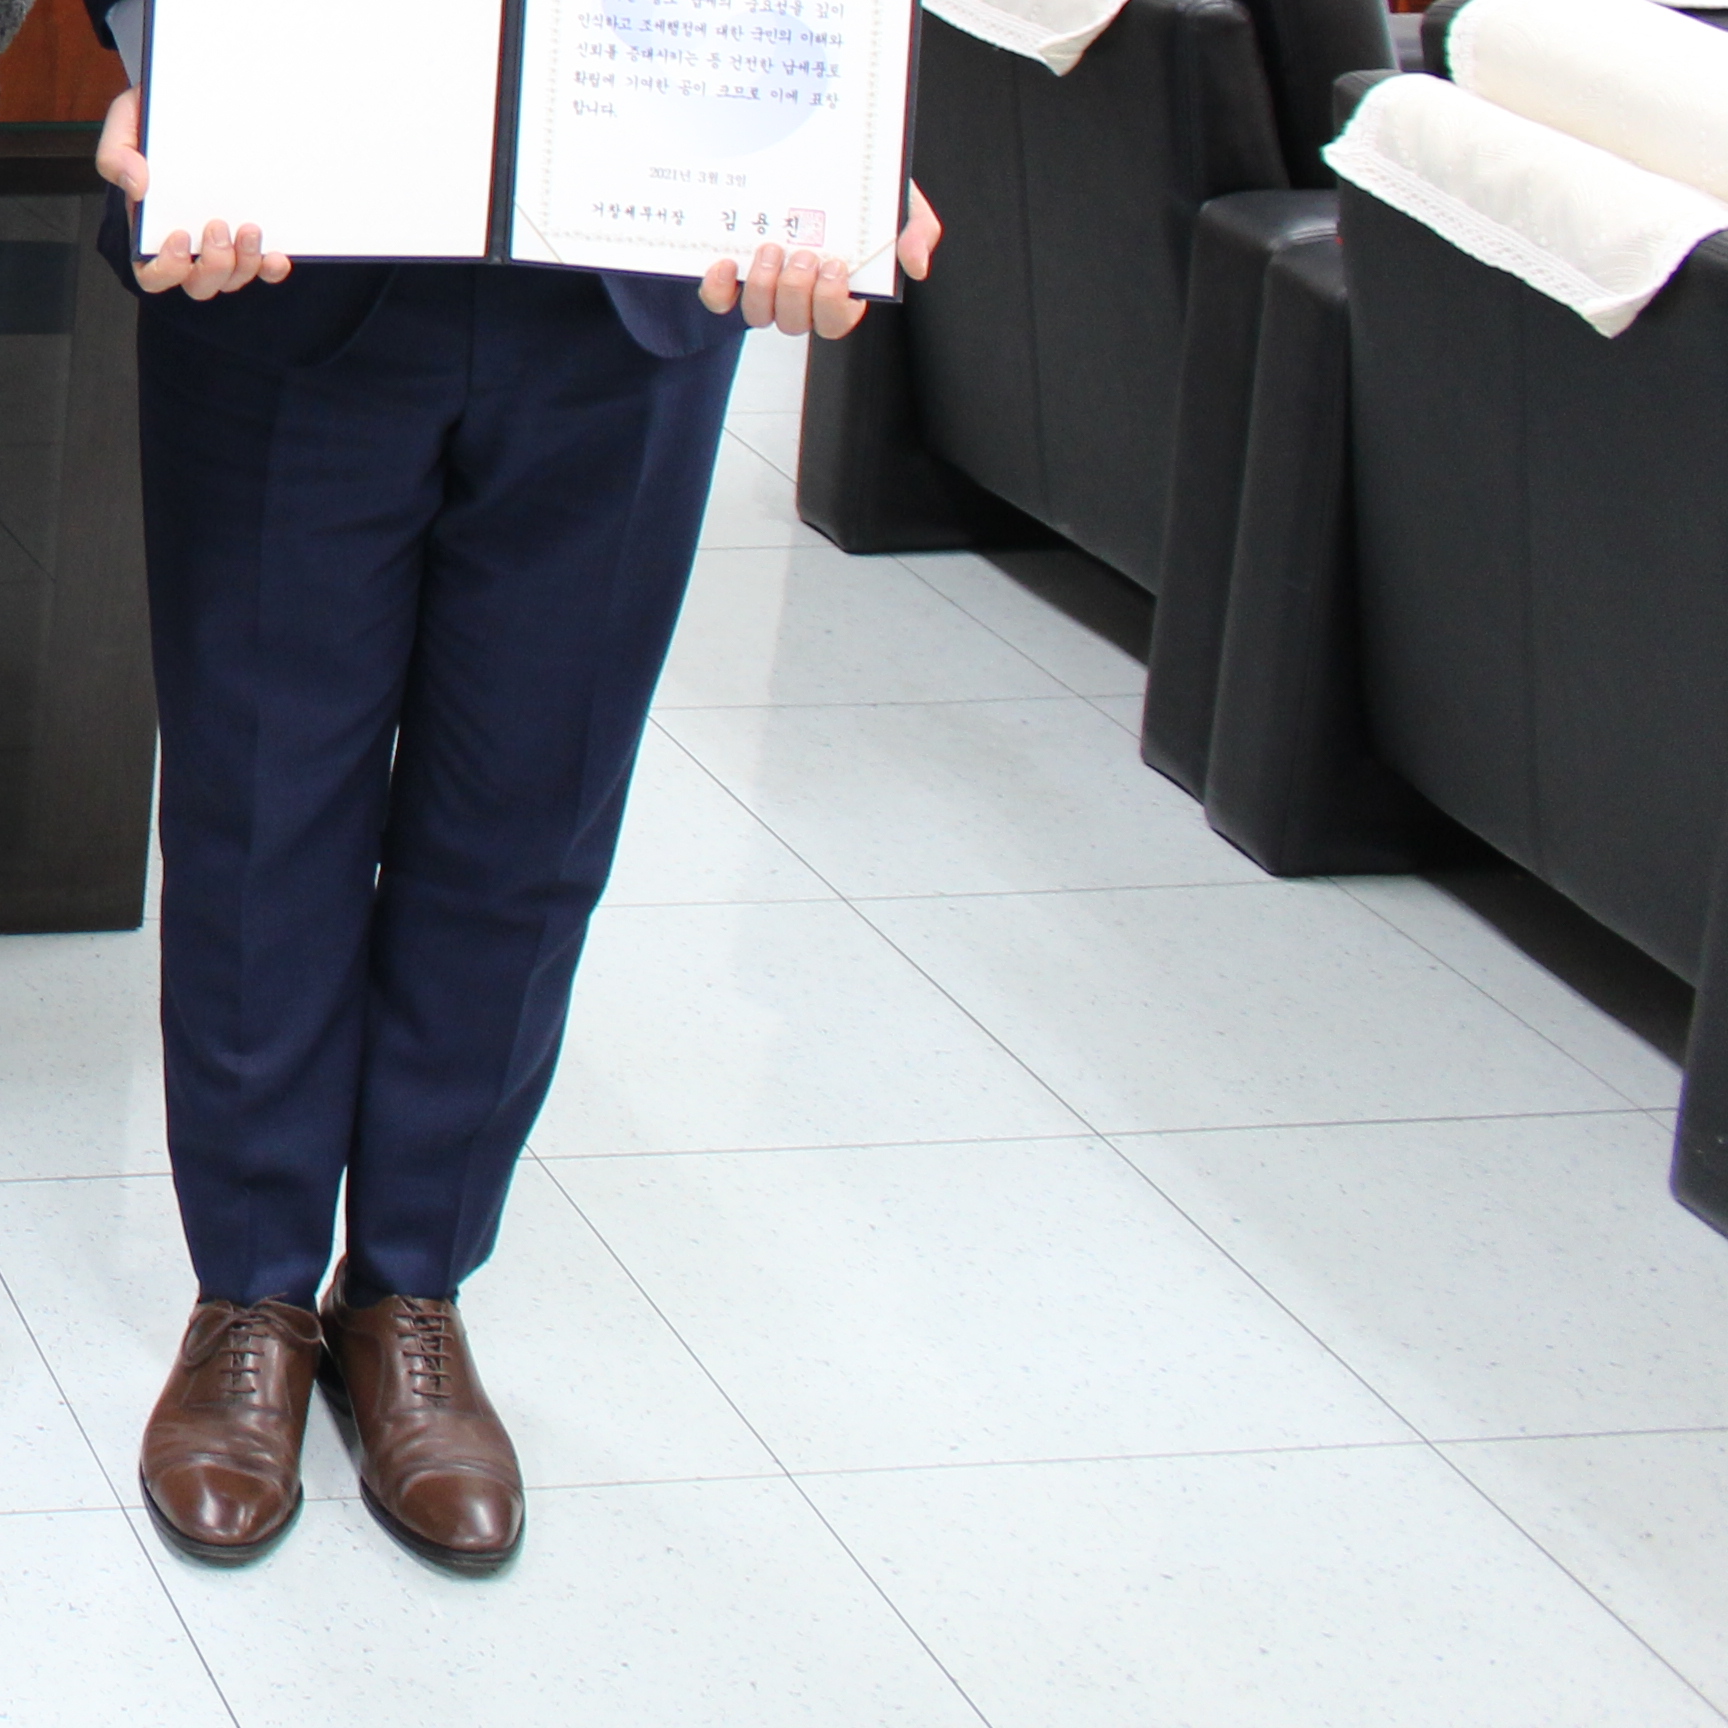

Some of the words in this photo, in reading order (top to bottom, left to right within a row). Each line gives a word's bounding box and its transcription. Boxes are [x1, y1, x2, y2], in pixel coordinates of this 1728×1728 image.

[816, 1, 845, 19] 깊이
[578, 12, 632, 31] 인식하고
[639, 19, 707, 38] 조세행정에
[716, 24, 744, 42] 대한
[750, 26, 792, 45] 국민의
[800, 30, 843, 48] 이해와
[577, 41, 618, 61] 신뢰를
[627, 45, 699, 67] 증대시키는
[706, 52, 722, 70] 등
[730, 54, 774, 75] 건전한
[782, 58, 840, 79] 납세풍토
[574, 70, 615, 89] 확립에
[626, 74, 670, 95] 기여한
[678, 79, 707, 97] 공이
[716, 84, 761, 101] 크므로
[770, 87, 799, 104] 이에
[809, 92, 839, 110] 표창
[649, 166, 692, 183] 2021년
[698, 171, 719, 185] 3월
[725, 173, 747, 188] 3일
[592, 201, 685, 226] 거창세무서장
[721, 209, 800, 239] 김용진
